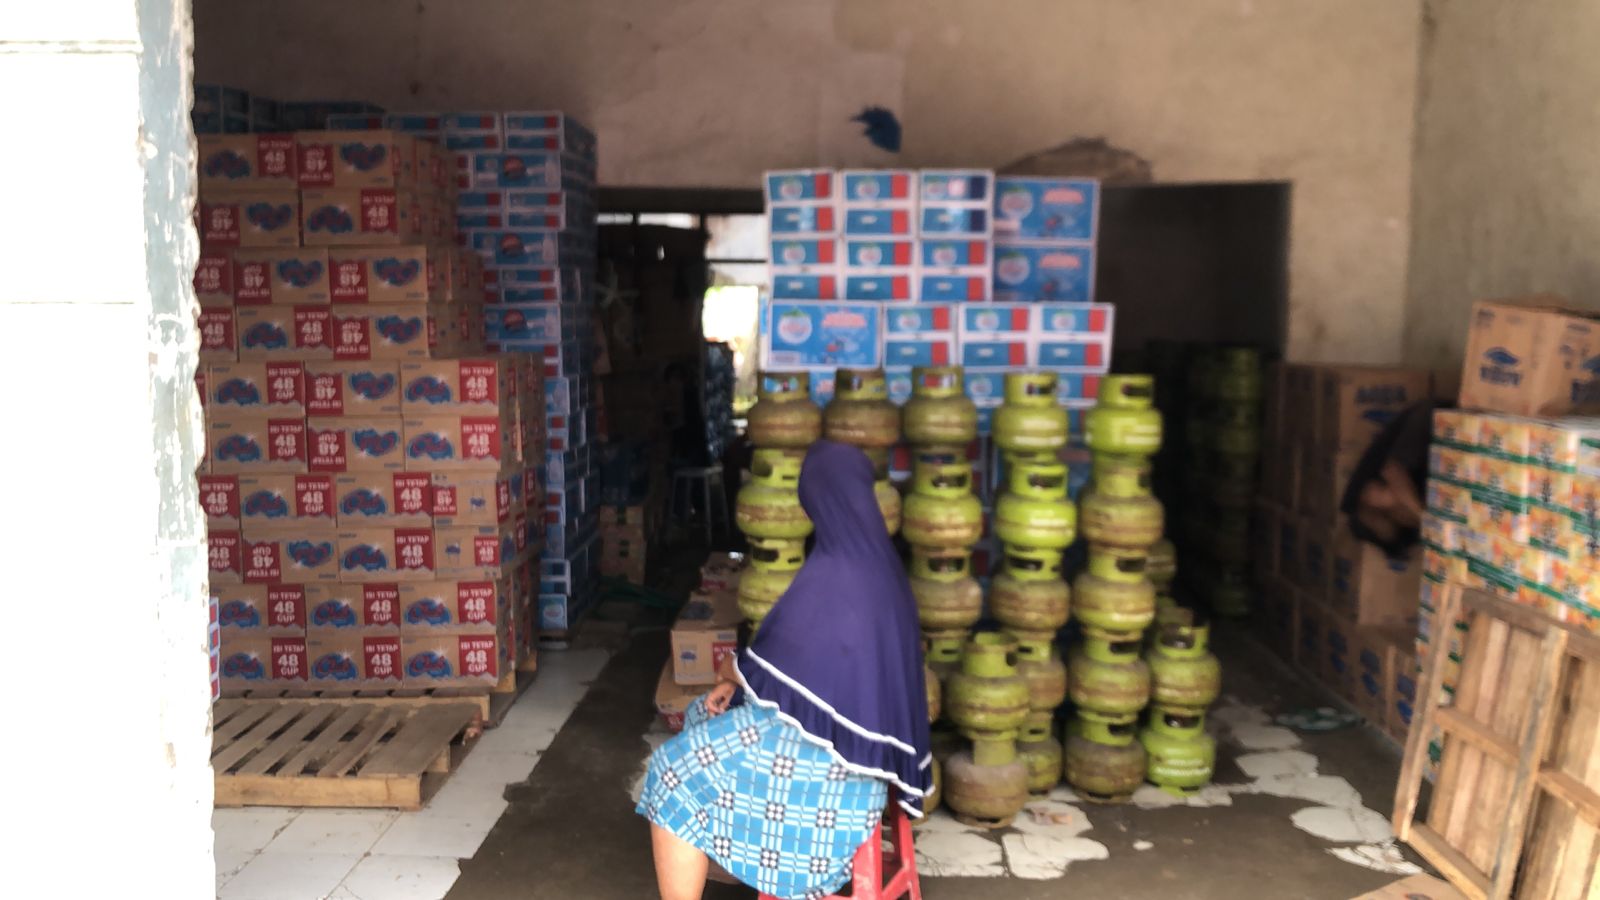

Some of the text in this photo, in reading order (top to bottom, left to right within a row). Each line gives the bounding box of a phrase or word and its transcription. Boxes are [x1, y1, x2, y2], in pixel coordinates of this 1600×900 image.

[340, 273, 361, 285] 48
[302, 321, 322, 333] 48
[304, 334, 323, 342] CUP
[342, 332, 363, 344] 48
[273, 378, 294, 389] 48
[466, 377, 488, 389] 48
[276, 391, 295, 399] CUP
[315, 387, 336, 399] 48
[468, 390, 488, 398] CUP
[474, 424, 496, 432] TETAP
[275, 435, 296, 446] 48
[318, 434, 336, 442] CUP
[468, 434, 489, 446] 48
[278, 448, 296, 456] CUP
[318, 444, 339, 455] 48
[470, 447, 490, 456] CUP
[207, 492, 228, 504] 48
[302, 492, 323, 504] 48
[401, 488, 422, 500] 48
[209, 505, 228, 513] CUP
[305, 504, 324, 513] CUP
[403, 502, 422, 510] CUP
[408, 535, 429, 543] TETAP
[209, 547, 229, 559] 48
[252, 546, 271, 555] CUP
[402, 545, 423, 557] 48
[253, 556, 273, 567] 48
[274, 601, 294, 613] 48
[370, 600, 391, 612] 48
[465, 599, 486, 611] 48
[277, 614, 295, 622] CUP
[373, 613, 392, 621] CUP
[467, 612, 486, 620] CUP
[377, 644, 398, 652] TETAP
[472, 641, 493, 649] TETAP
[278, 654, 299, 666] 48
[371, 654, 392, 666] 48
[465, 650, 487, 663] 48
[280, 667, 299, 675] CUP
[468, 664, 487, 672] CUP
